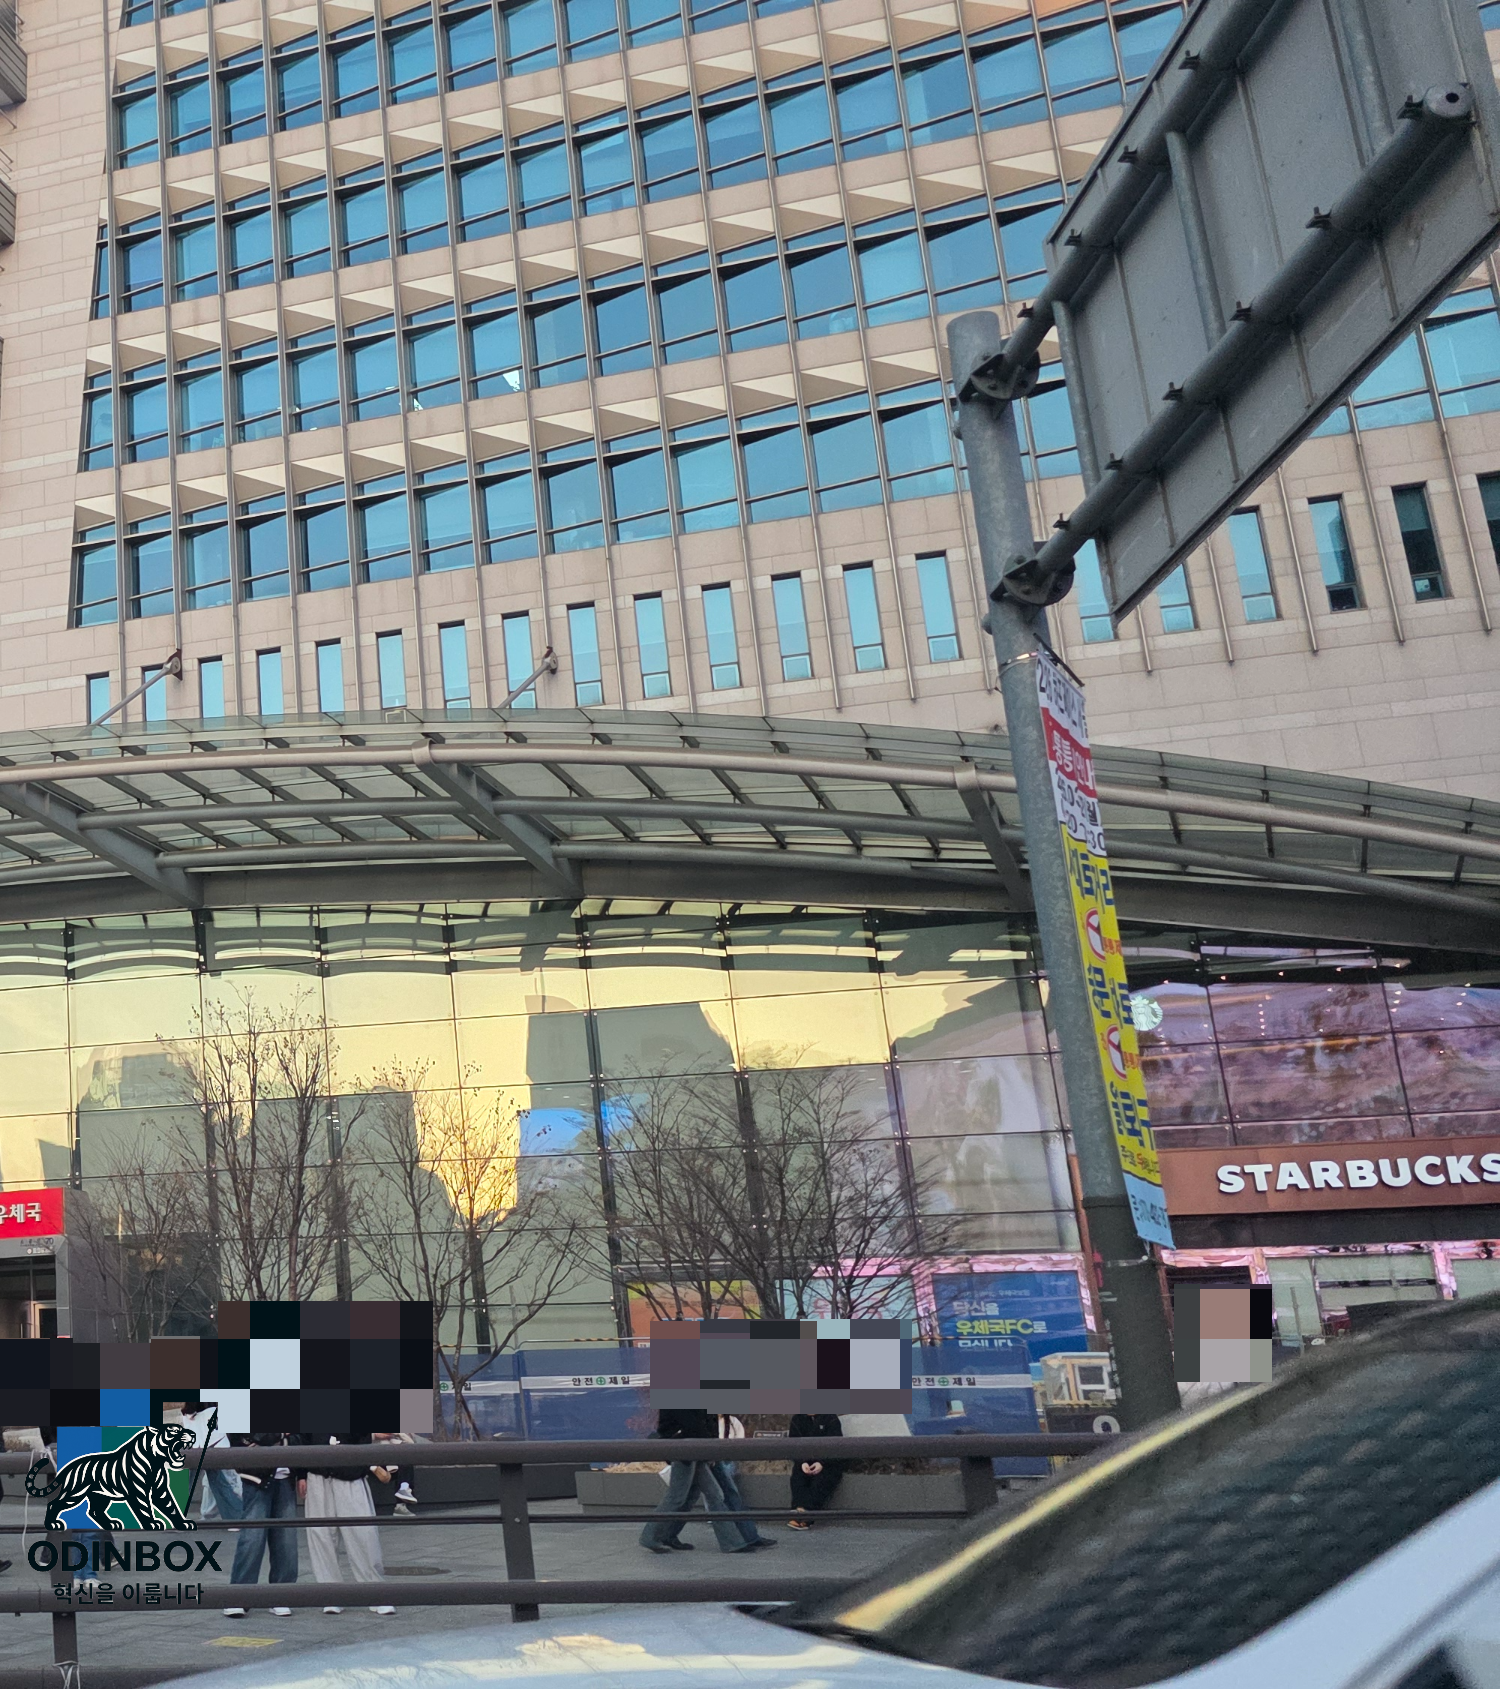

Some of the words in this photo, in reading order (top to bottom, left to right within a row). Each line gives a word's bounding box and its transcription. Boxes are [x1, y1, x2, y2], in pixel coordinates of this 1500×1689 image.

[1216, 1152, 1500, 1194] STARBUCKS
[952, 1300, 1000, 1317] 당신을
[956, 1318, 1048, 1336] 우체국FC로
[608, 1375, 631, 1385] 제일
[952, 1376, 977, 1387] 제일
